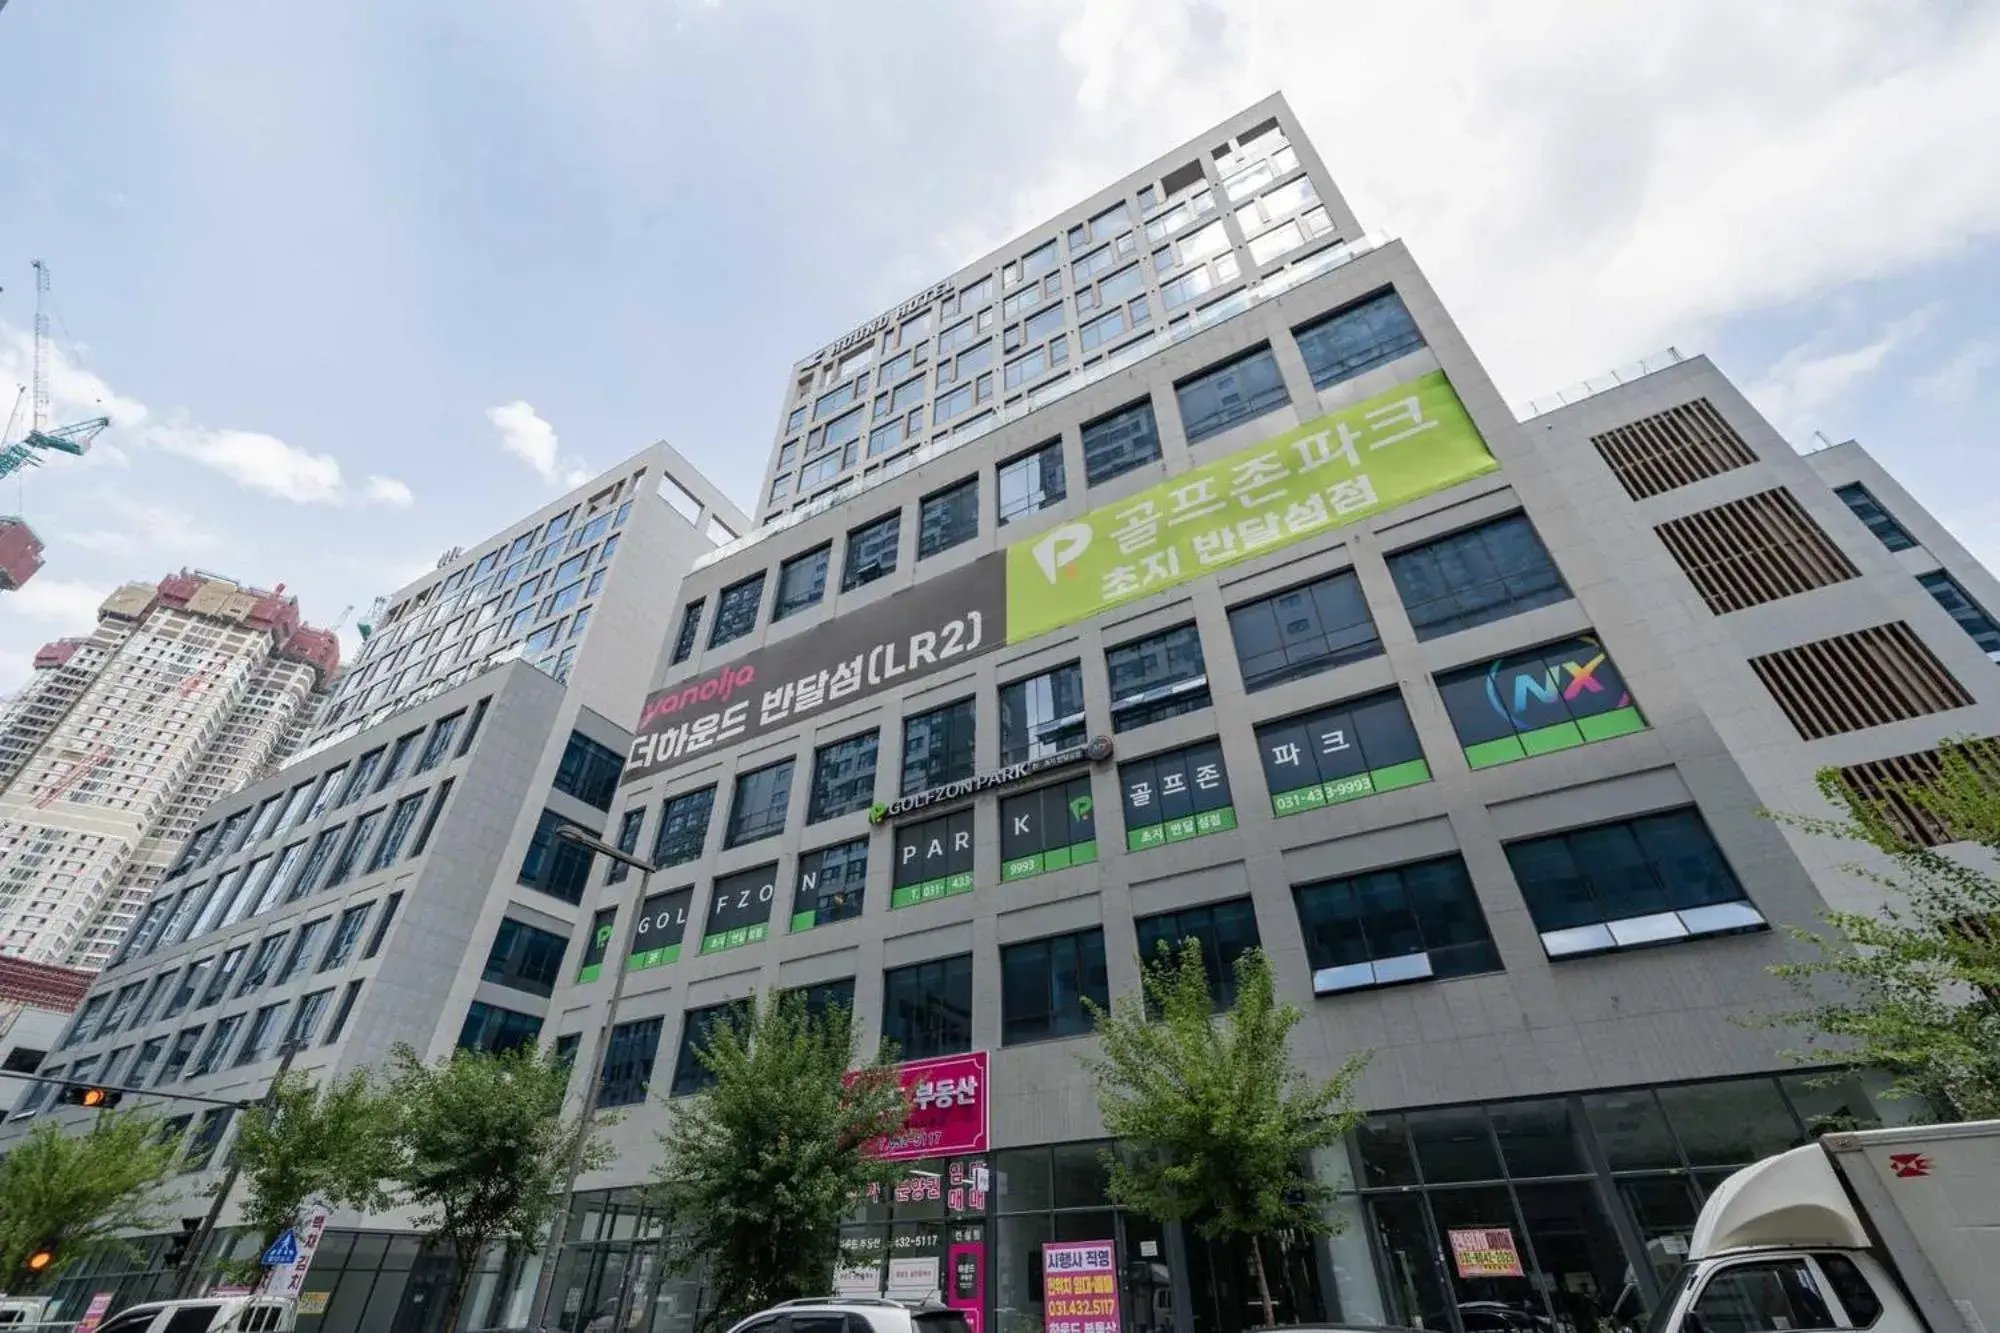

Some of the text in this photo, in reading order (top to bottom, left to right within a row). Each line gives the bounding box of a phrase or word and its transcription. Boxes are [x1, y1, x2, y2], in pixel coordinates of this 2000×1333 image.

[1109, 395, 1440, 556] 골프존파크
[1102, 473, 1379, 600] 초지 반달섬점
[641, 662, 757, 728] yanolja
[624, 699, 750, 772] 더하운드
[1271, 729, 1351, 766] 파크
[1129, 763, 1220, 808] 골프존
[913, 1075, 978, 1111] 부동산
[1086, 1250, 1110, 1267] 직영
